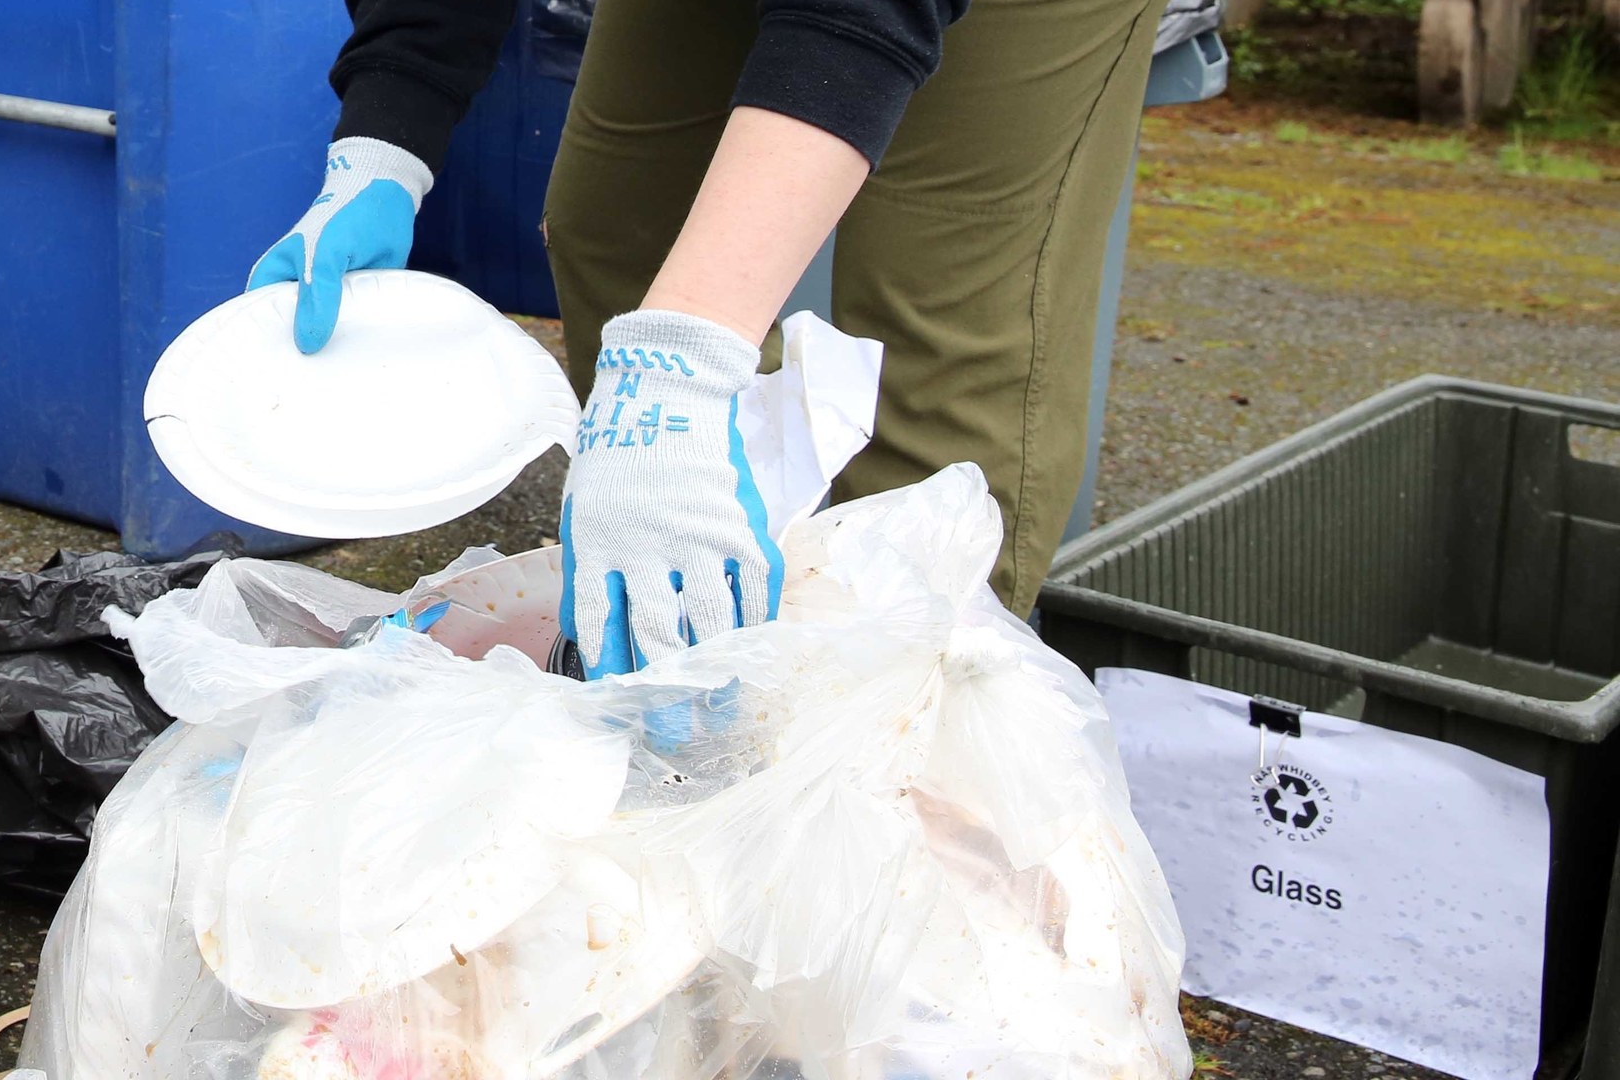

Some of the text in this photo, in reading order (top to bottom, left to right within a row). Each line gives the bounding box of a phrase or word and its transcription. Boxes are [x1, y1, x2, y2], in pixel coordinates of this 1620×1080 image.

[614, 372, 642, 398] M
[578, 401, 662, 429] FIT
[576, 428, 659, 455] ATLAS
[1278, 764, 1333, 803] WHIDBEY
[1251, 794, 1334, 842] RECYCLING
[1251, 864, 1342, 910] Glass
